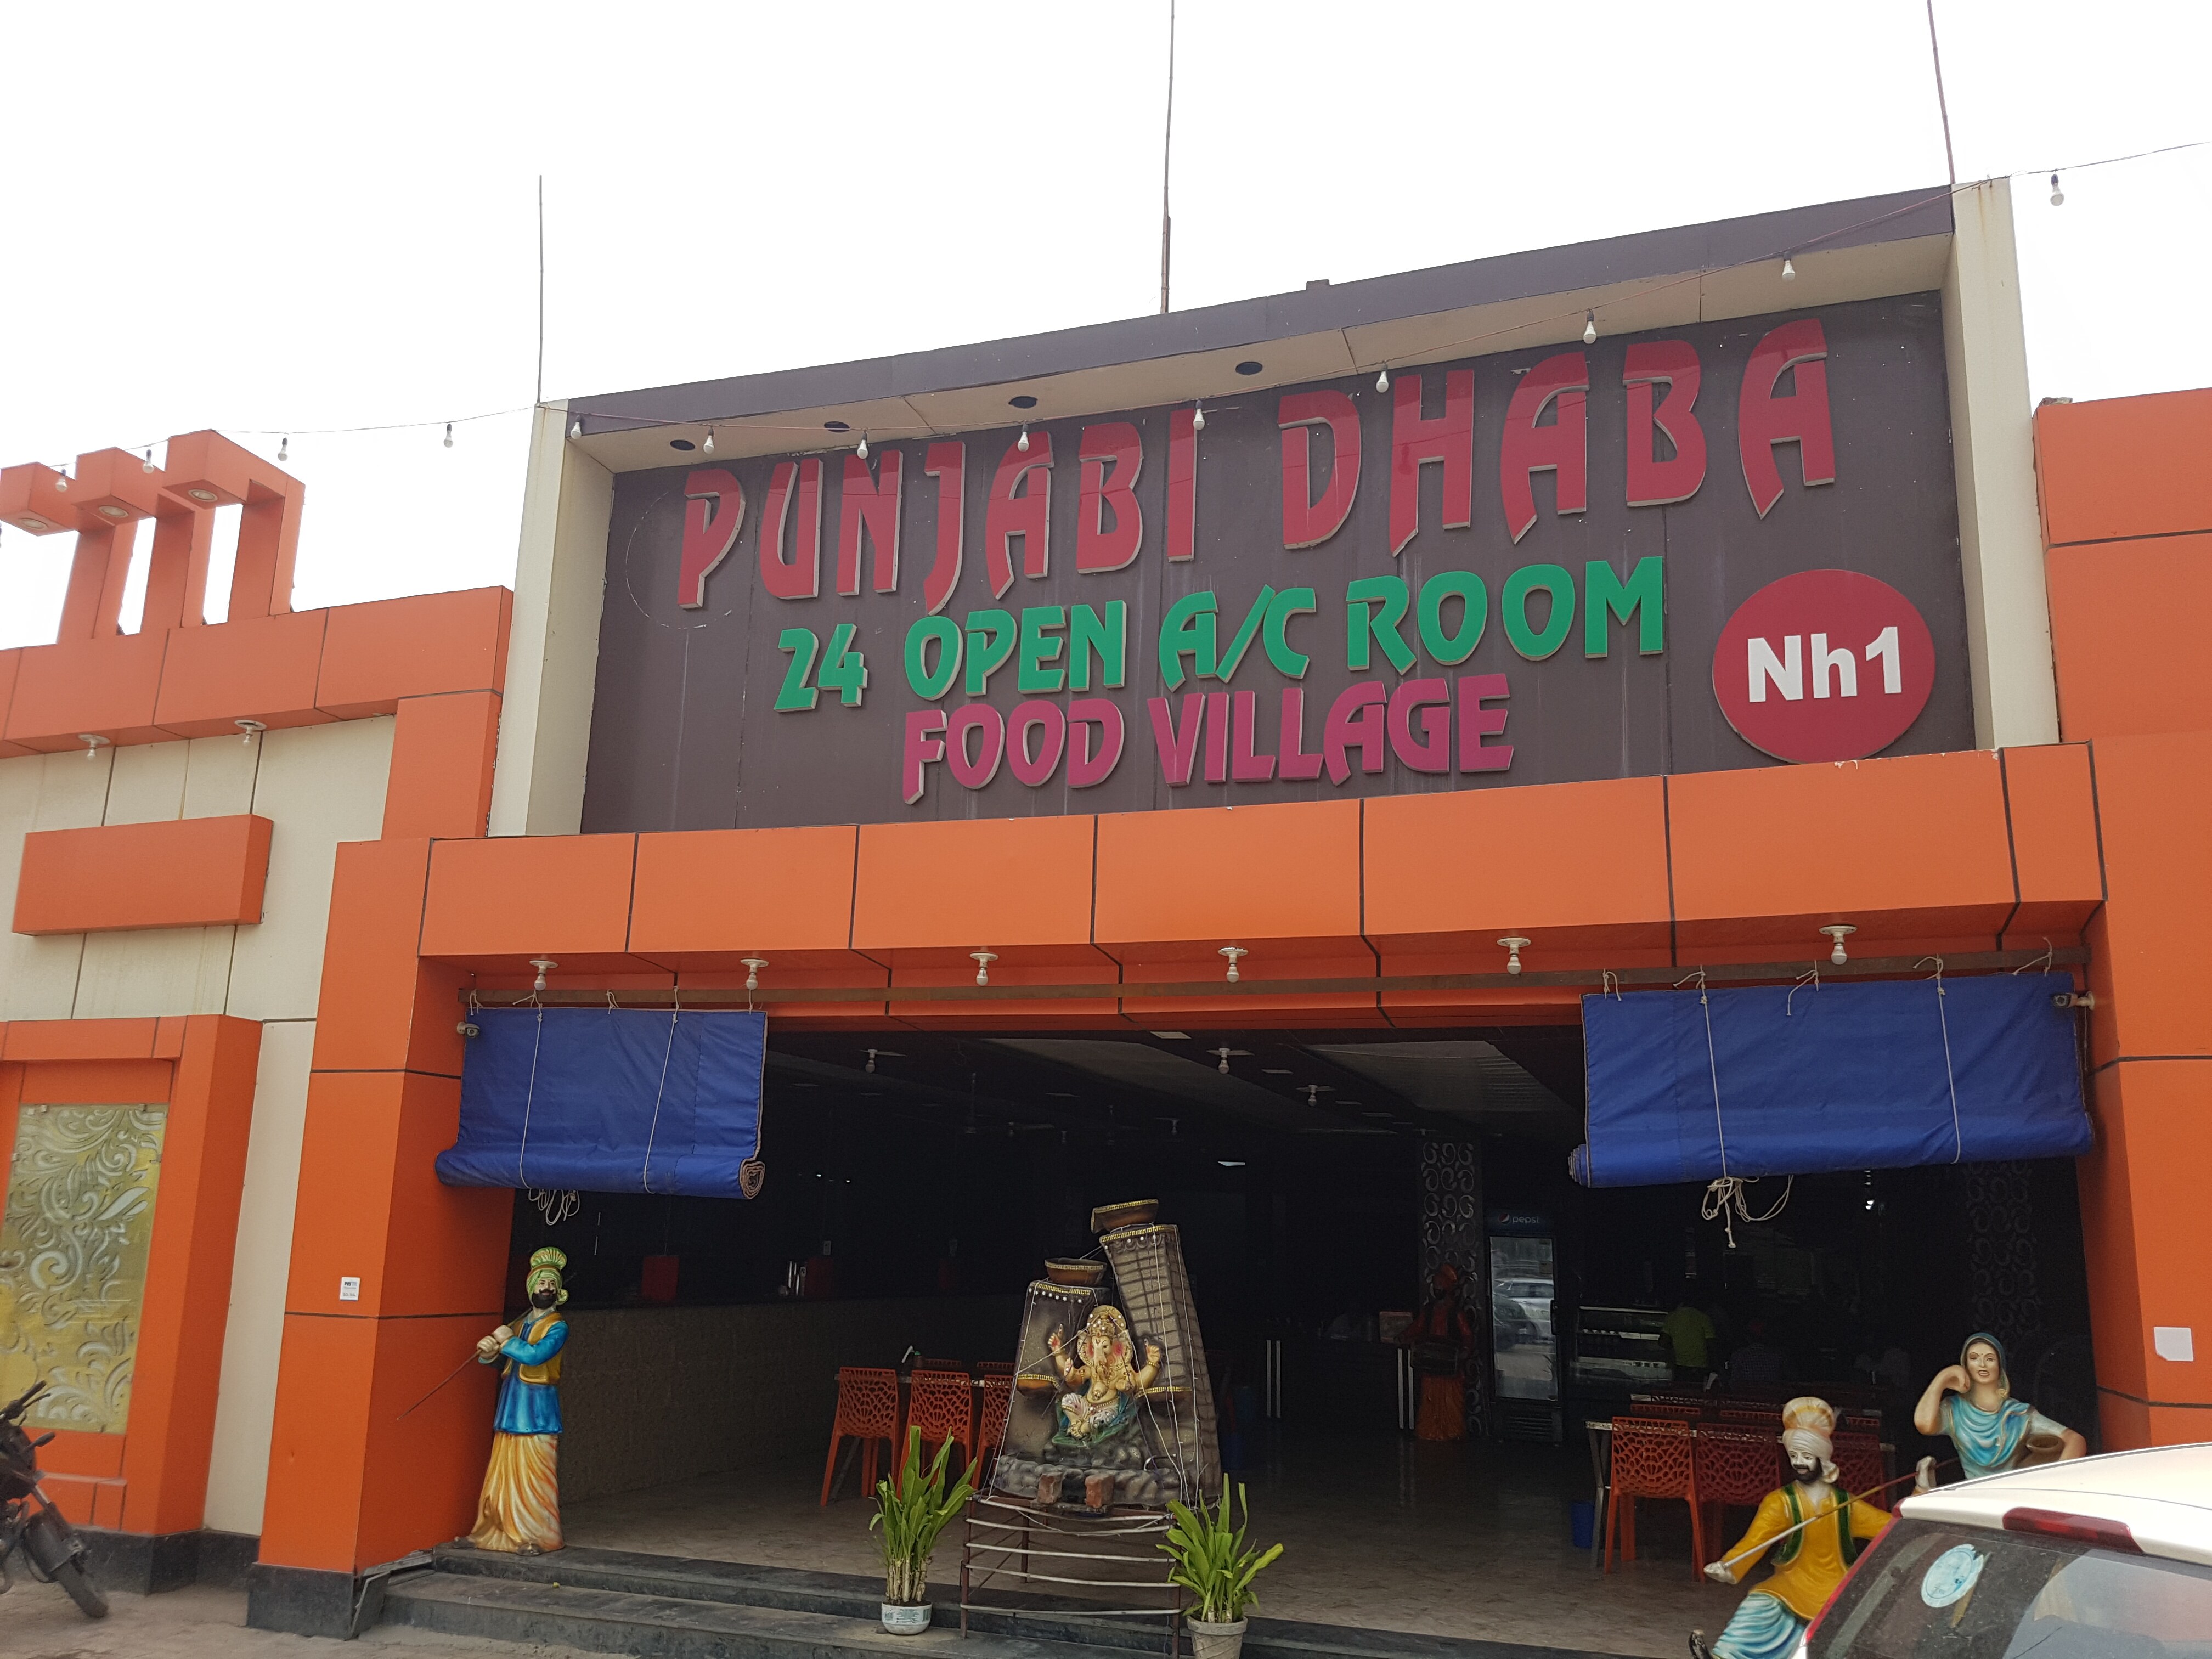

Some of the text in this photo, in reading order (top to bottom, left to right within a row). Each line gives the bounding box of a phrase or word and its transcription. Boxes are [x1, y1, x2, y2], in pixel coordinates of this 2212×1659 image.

[677, 318, 1837, 615] PUNJABI DHABA
[774, 556, 1664, 713] 24 OPEN A/C ROOM
[1747, 626, 1903, 703] Nh1
[902, 673, 1515, 805] FOOD VILLAGE
[1512, 1215, 1540, 1224] pepsi
